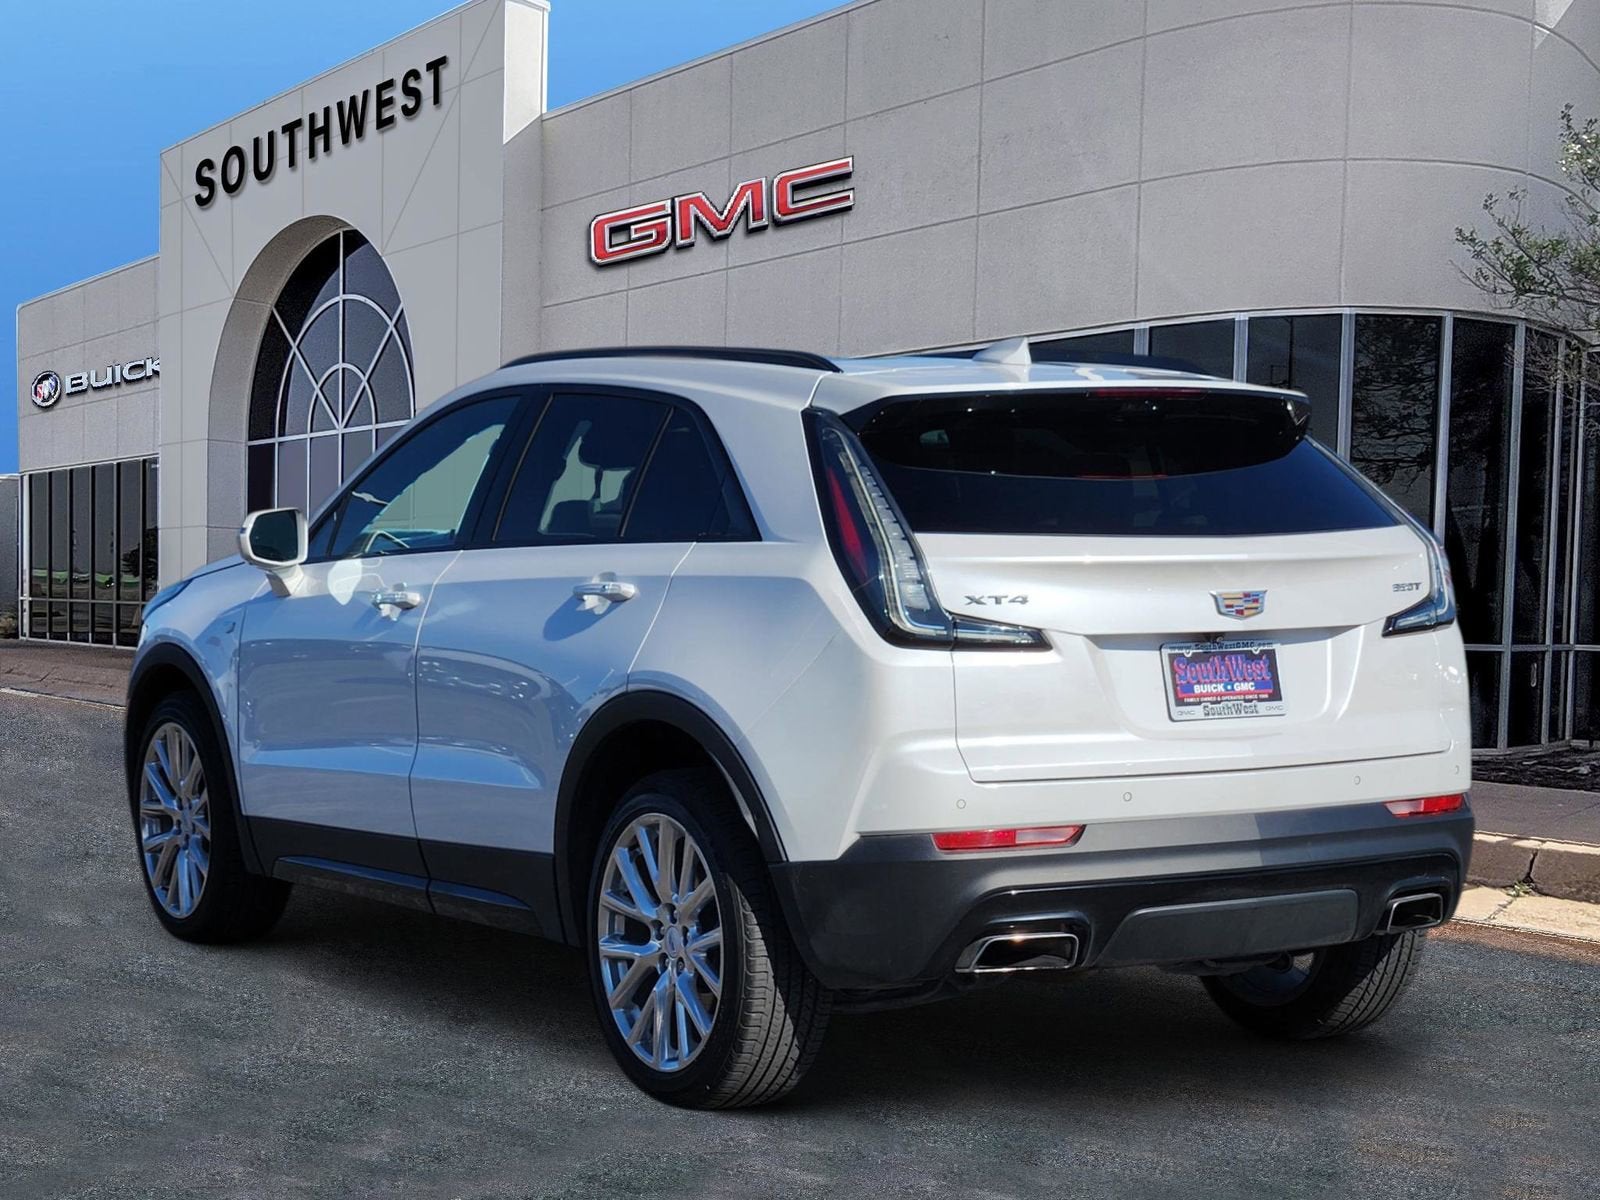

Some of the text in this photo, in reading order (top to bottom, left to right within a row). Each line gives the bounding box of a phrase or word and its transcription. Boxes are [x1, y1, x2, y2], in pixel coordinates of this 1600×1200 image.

[194, 56, 448, 207] SOUTHWEST
[589, 155, 854, 264] GMC
[65, 357, 160, 394] BUICK
[964, 595, 1029, 605] XT4
[1174, 654, 1272, 684] SouthWest
[1193, 682, 1256, 694] BUICK GMC
[1203, 702, 1260, 717] SouthWest
